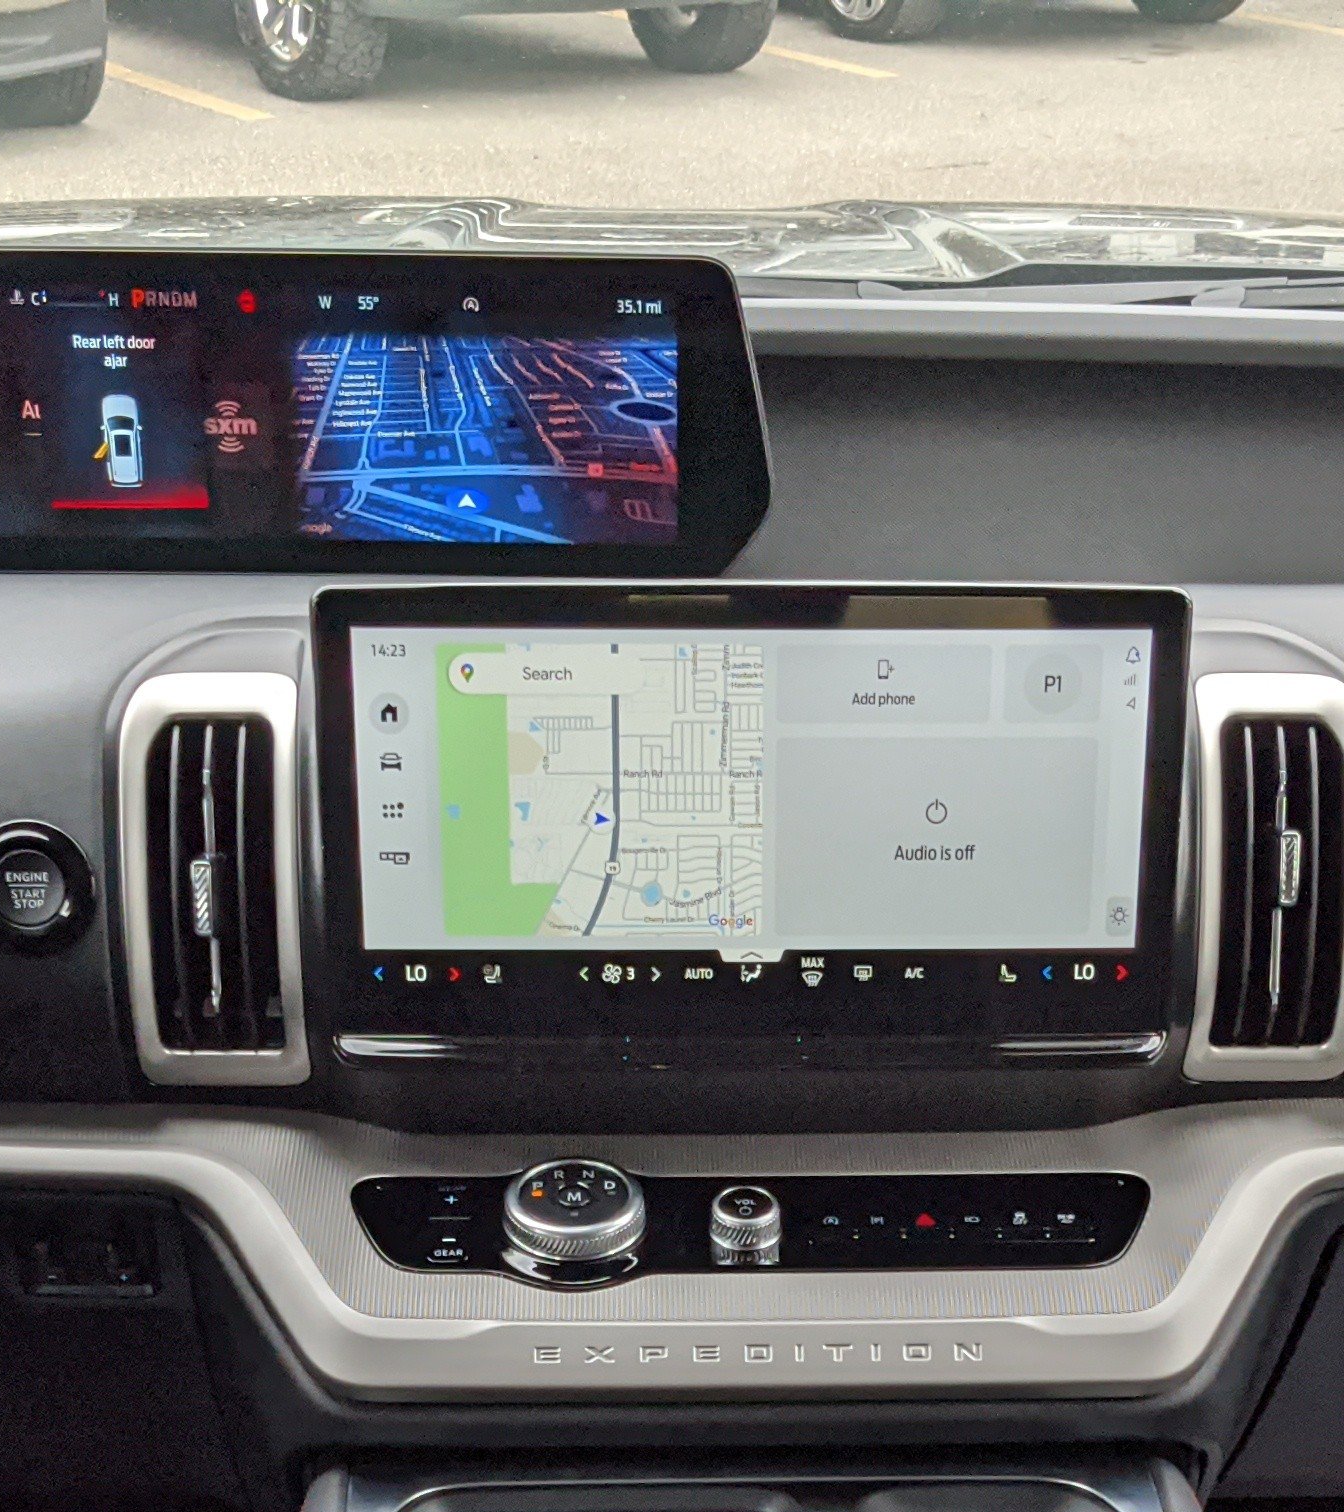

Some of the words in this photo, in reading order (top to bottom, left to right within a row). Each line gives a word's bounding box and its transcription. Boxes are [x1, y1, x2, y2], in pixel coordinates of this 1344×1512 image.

[317, 295, 332, 310] W
[617, 299, 643, 313] 35.1
[72, 334, 102, 349] Rear
[103, 334, 125, 349] left
[127, 334, 156, 349] door
[104, 354, 127, 370] ajar
[204, 417, 257, 436] sxm
[370, 643, 407, 658] 14:23
[522, 665, 573, 682] Search
[1044, 675, 1062, 694] P1
[852, 692, 877, 706] Add
[878, 692, 916, 708] phone
[623, 769, 650, 779] Ranch
[651, 769, 663, 779] Rd
[729, 769, 755, 779] Ranch
[894, 845, 937, 862] Audio
[940, 845, 951, 862] is
[954, 845, 976, 862] off
[5, 871, 50, 883] ENGINE
[11, 889, 46, 899] START
[14, 899, 45, 910] STOP
[708, 914, 754, 930] Google
[801, 958, 825, 969] MAX
[405, 965, 428, 982] LO
[626, 967, 635, 982] 3
[684, 967, 714, 981] AUTO
[904, 967, 925, 980] A/C
[1074, 964, 1096, 981] LO
[554, 1170, 564, 1180] R
[582, 1170, 595, 1180] N
[604, 1181, 616, 1191] D
[567, 1192, 582, 1202] M
[735, 1199, 756, 1207] VOL
[434, 1249, 463, 1258] GEAR
[532, 1341, 986, 1367] EXPEDITION
